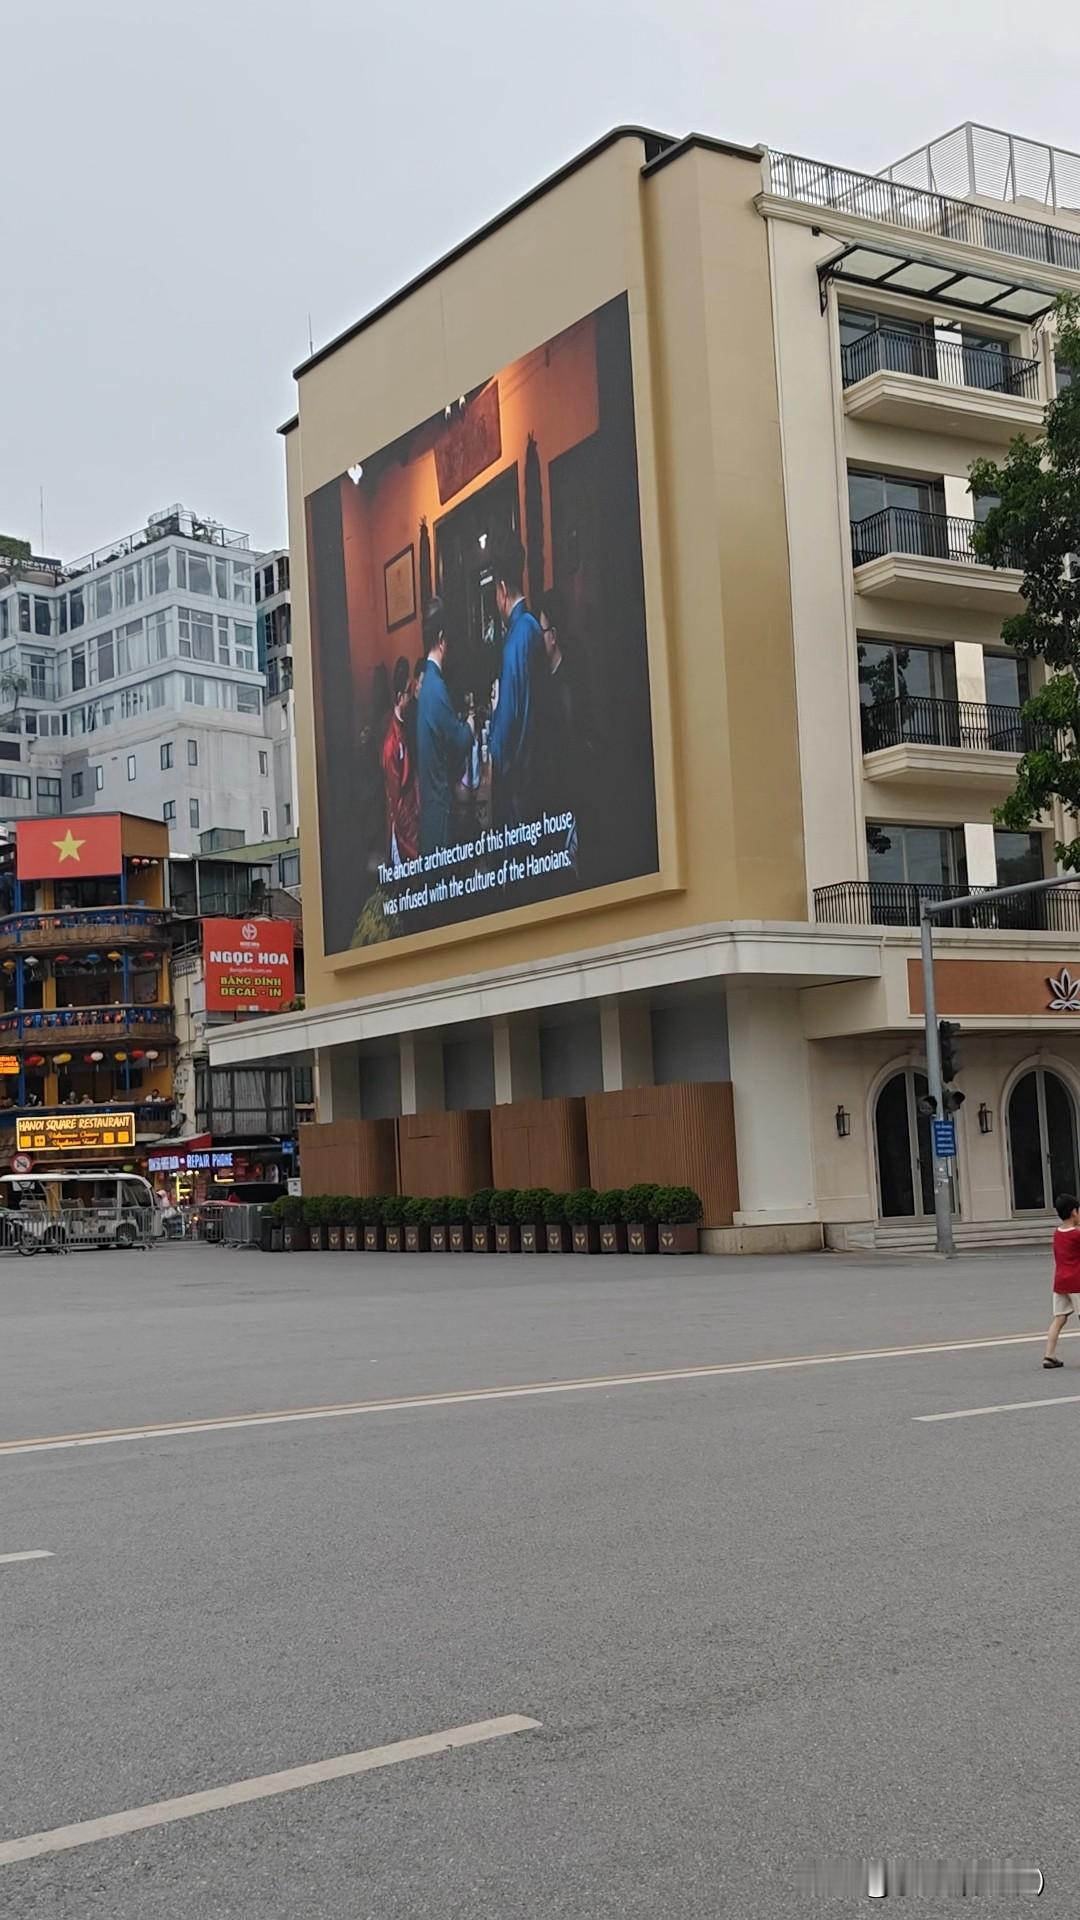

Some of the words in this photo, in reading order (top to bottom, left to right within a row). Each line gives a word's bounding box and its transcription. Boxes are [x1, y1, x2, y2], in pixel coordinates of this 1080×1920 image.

[378, 863, 393, 885] The
[392, 854, 423, 878] ancient
[424, 842, 474, 873] architecture
[474, 828, 486, 854] of
[486, 828, 504, 851] this
[504, 820, 542, 848] heritage
[542, 810, 573, 836] house
[383, 898, 398, 915] was
[399, 887, 428, 911] infused
[429, 878, 449, 902] with
[449, 876, 464, 897] the
[464, 869, 496, 894] culture
[497, 862, 508, 888] of
[508, 859, 524, 882] the
[526, 849, 572, 878] Hanoians.
[210, 951, 253, 965] NGỌC
[258, 952, 289, 965] HOA
[221, 988, 257, 996] DECAL
[269, 988, 282, 996] IN
[19, 1121, 44, 1131] HANOI
[46, 1119, 76, 1130] SQUARE
[79, 1117, 130, 1128] RESTAURANT
[187, 1154, 210, 1168] REPAIR
[212, 1152, 233, 1167] PHONE
